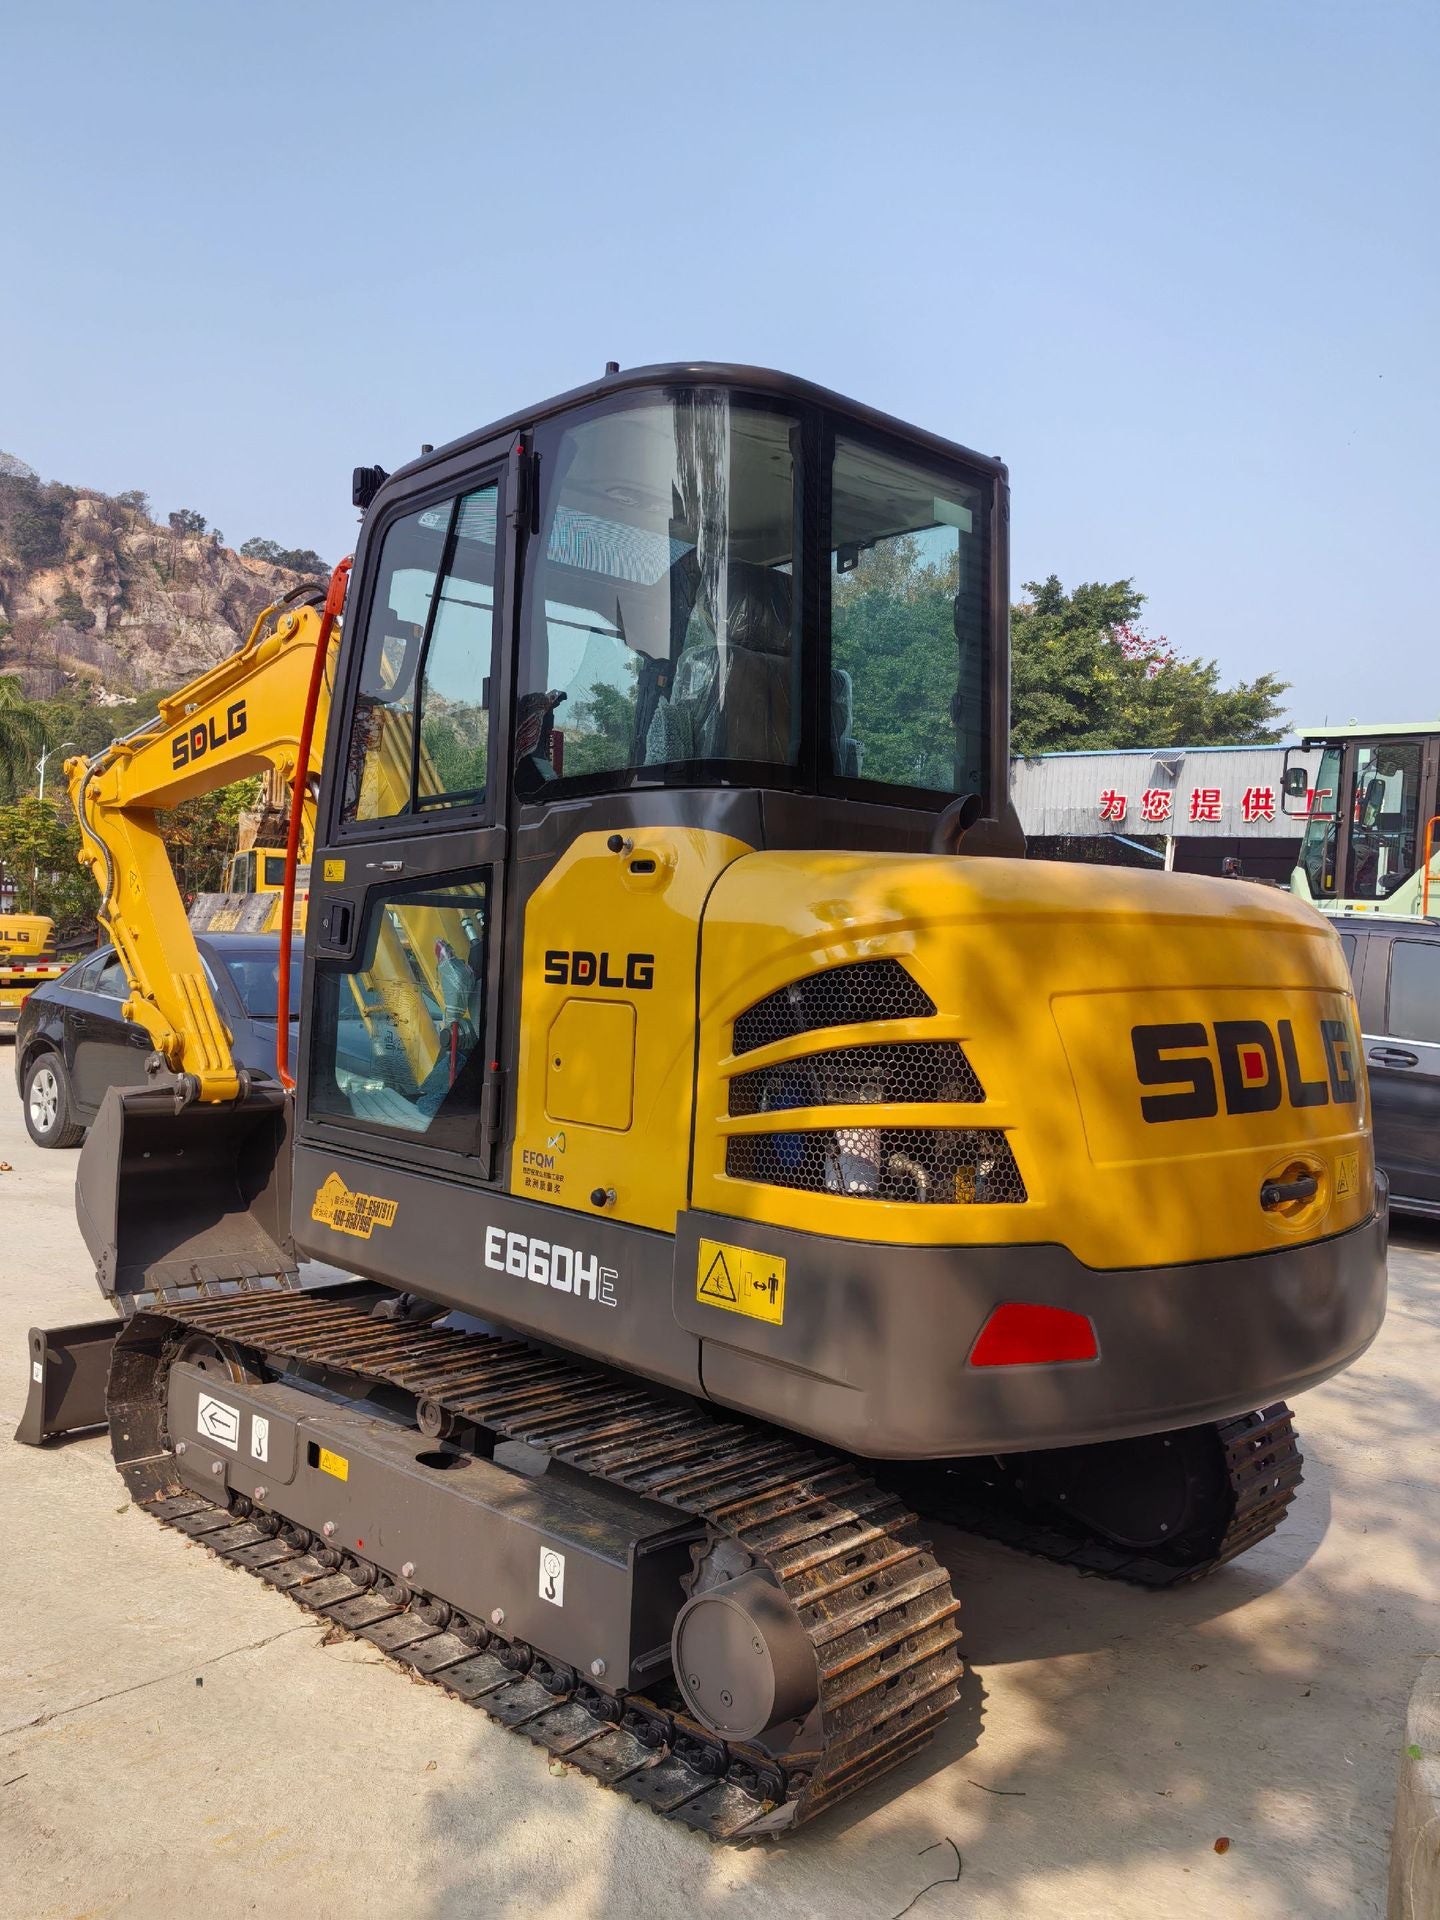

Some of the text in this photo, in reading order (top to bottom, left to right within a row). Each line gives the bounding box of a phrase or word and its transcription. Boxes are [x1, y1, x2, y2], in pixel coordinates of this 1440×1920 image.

[172, 699, 247, 771] SDLG
[0, 931, 29, 942] LG
[545, 950, 655, 990] SDLG
[1131, 1019, 1357, 1123] SDLG
[523, 1149, 555, 1169] EFQM
